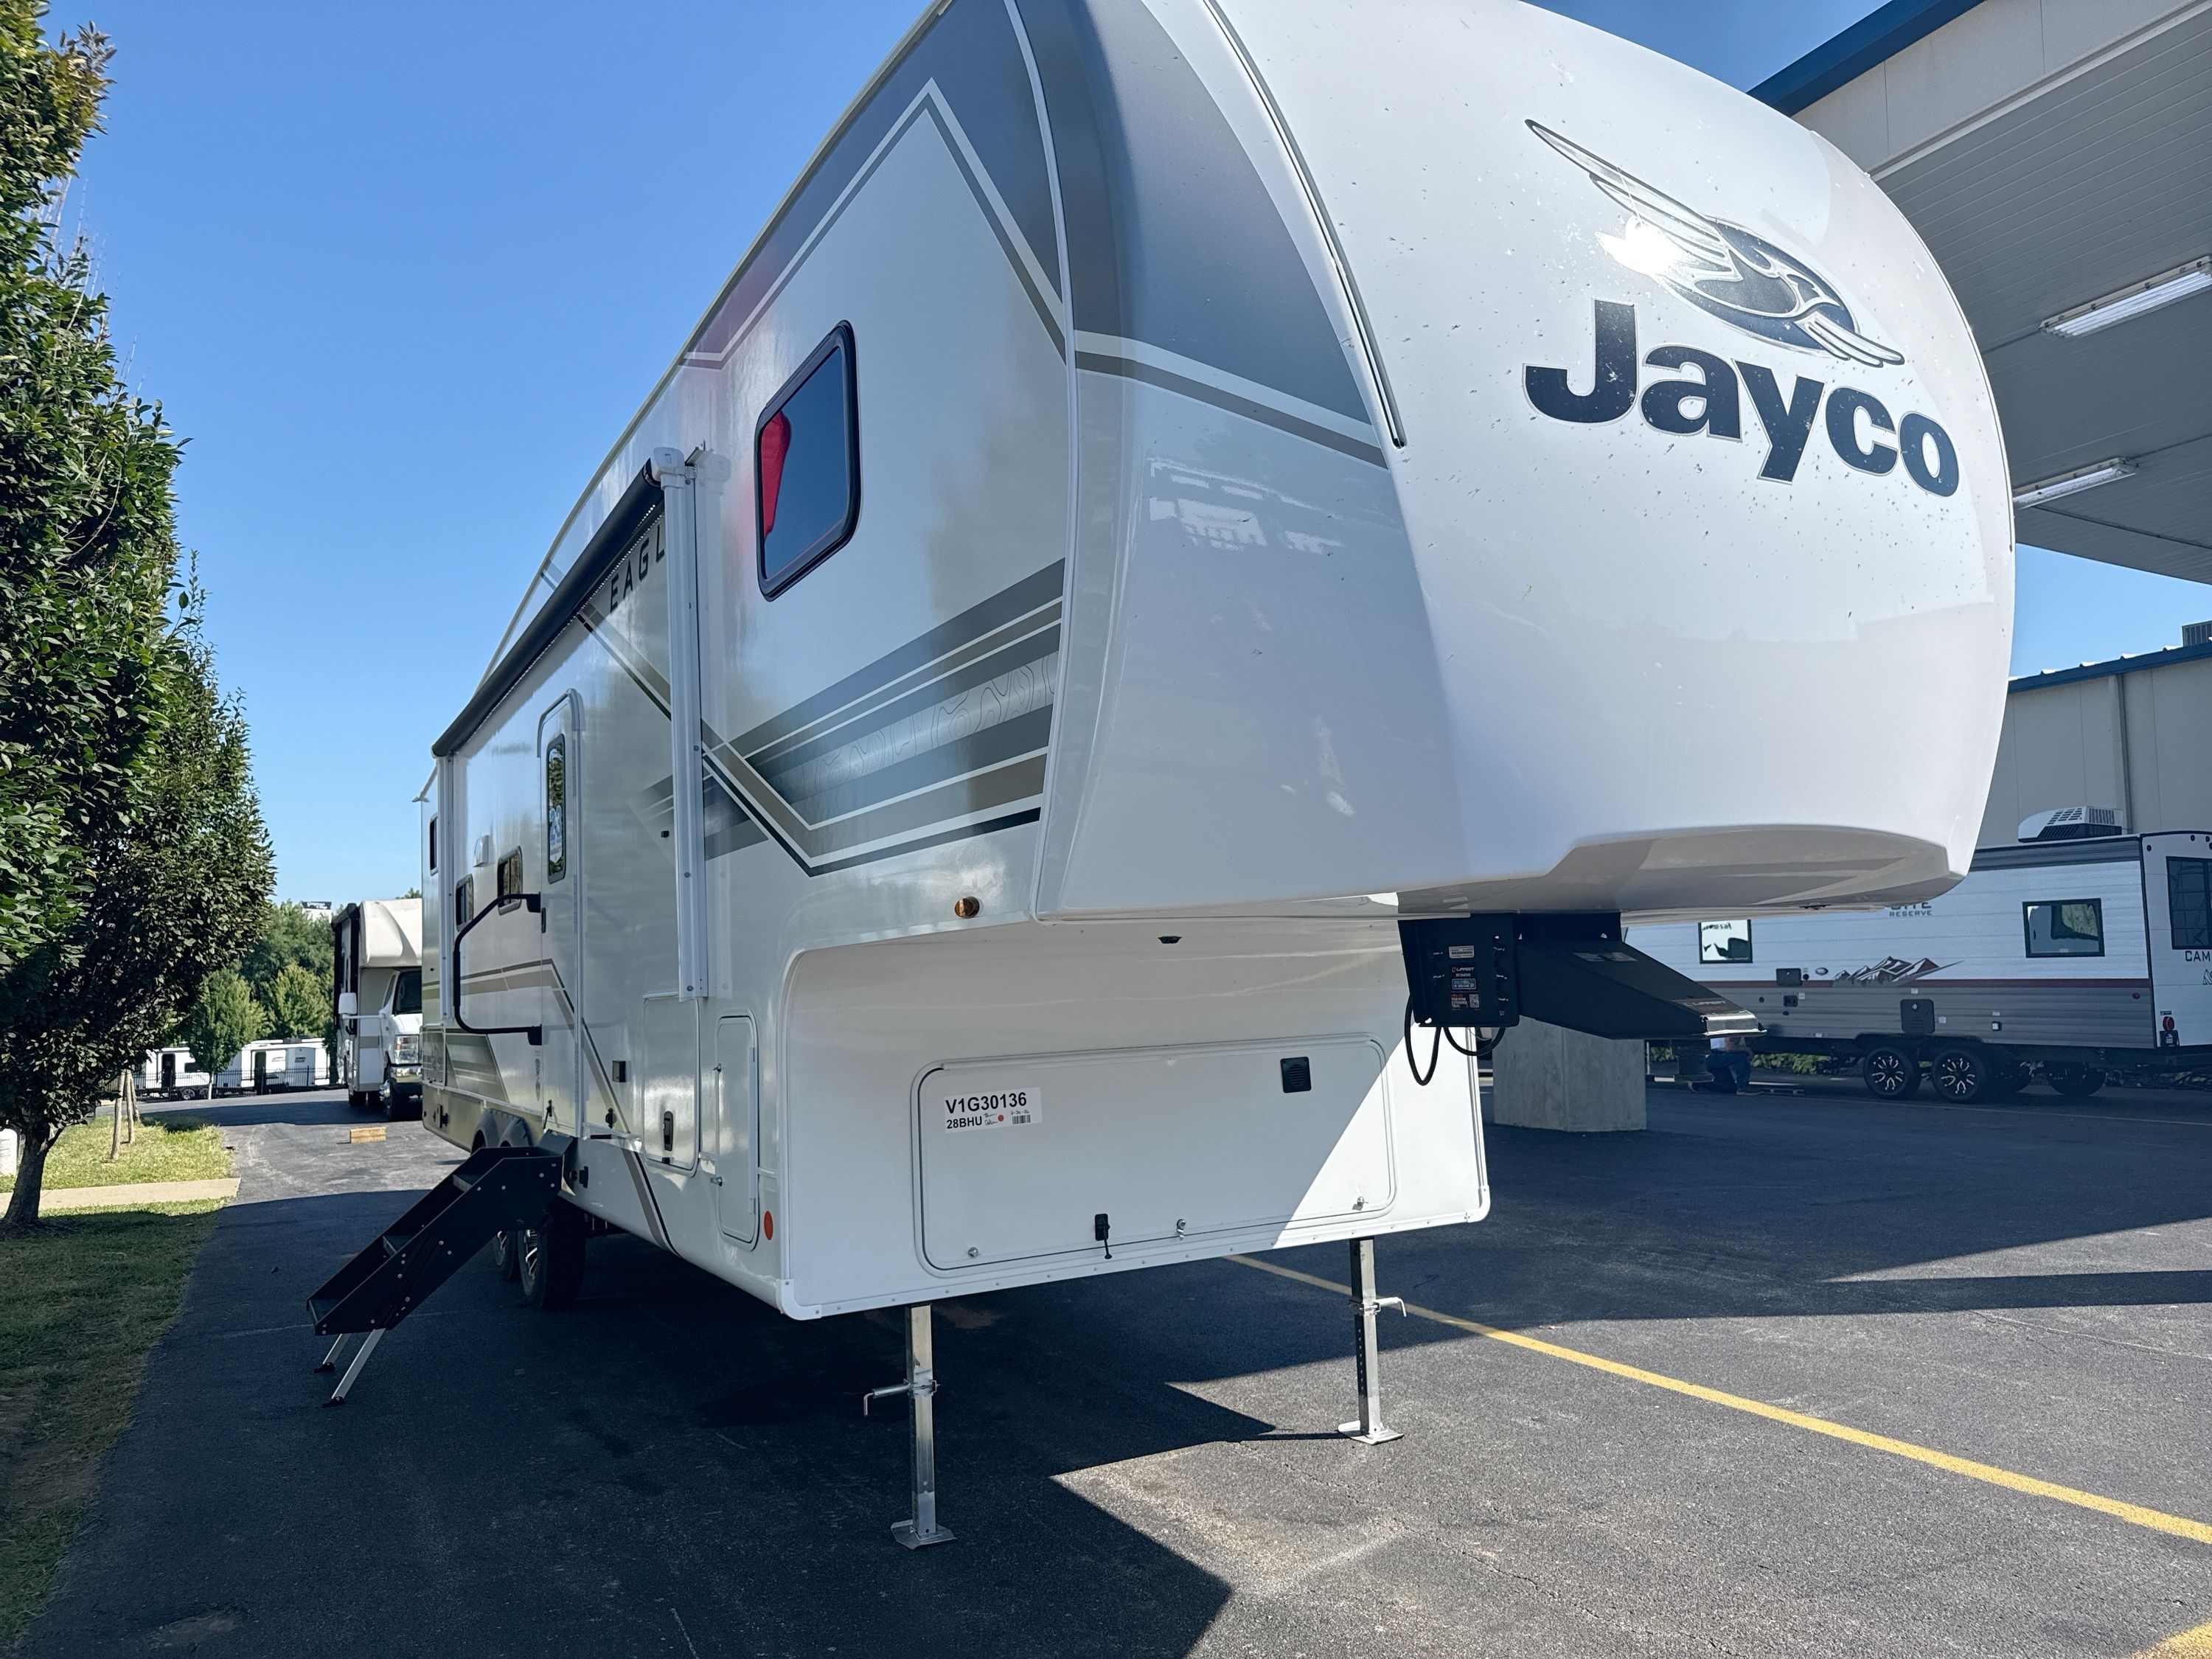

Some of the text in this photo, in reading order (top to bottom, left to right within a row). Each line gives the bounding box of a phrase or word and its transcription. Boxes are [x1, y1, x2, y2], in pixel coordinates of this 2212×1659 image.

[1521, 298, 1961, 498] Jayco
[1889, 909, 1933, 917] RESERVE
[2185, 950, 2211, 962] CAM
[945, 1091, 1027, 1114] V1G30136
[946, 1116, 983, 1129] 28BHU
